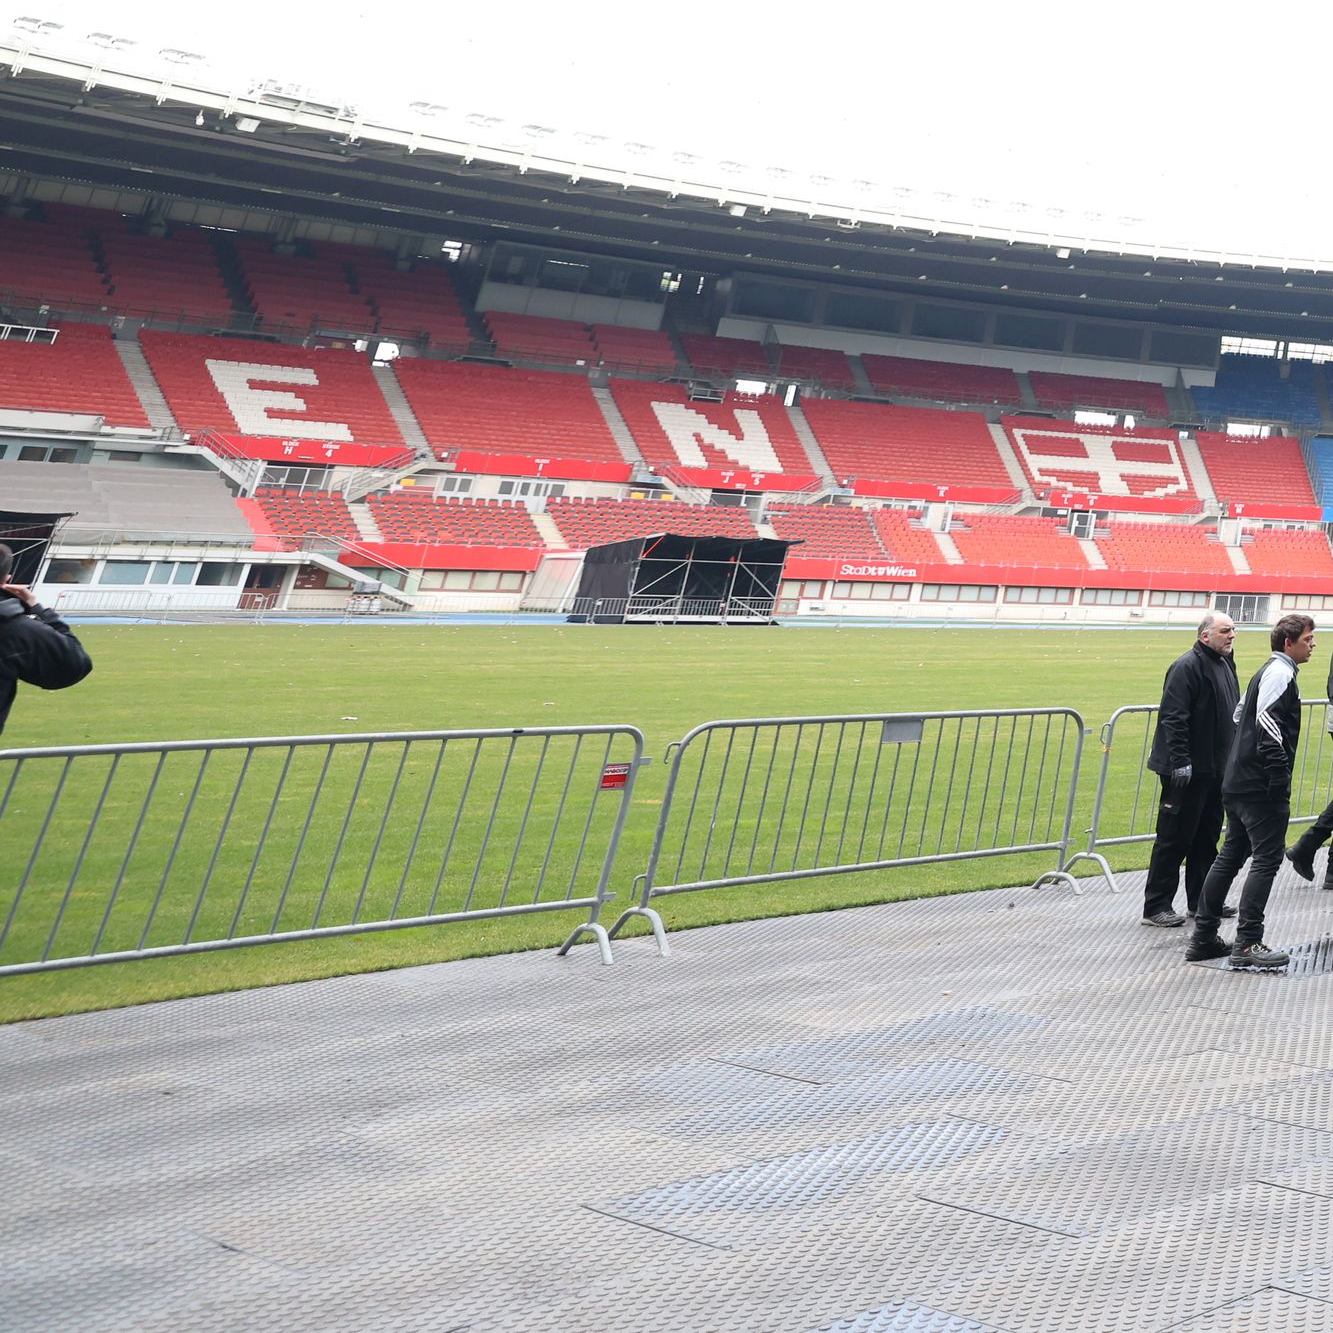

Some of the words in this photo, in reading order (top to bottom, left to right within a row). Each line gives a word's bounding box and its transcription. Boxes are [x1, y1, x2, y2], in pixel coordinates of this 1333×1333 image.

[205, 359, 354, 442] E
[284, 446, 293, 455] H
[650, 401, 784, 473] N
[885, 566, 917, 577] Wien
